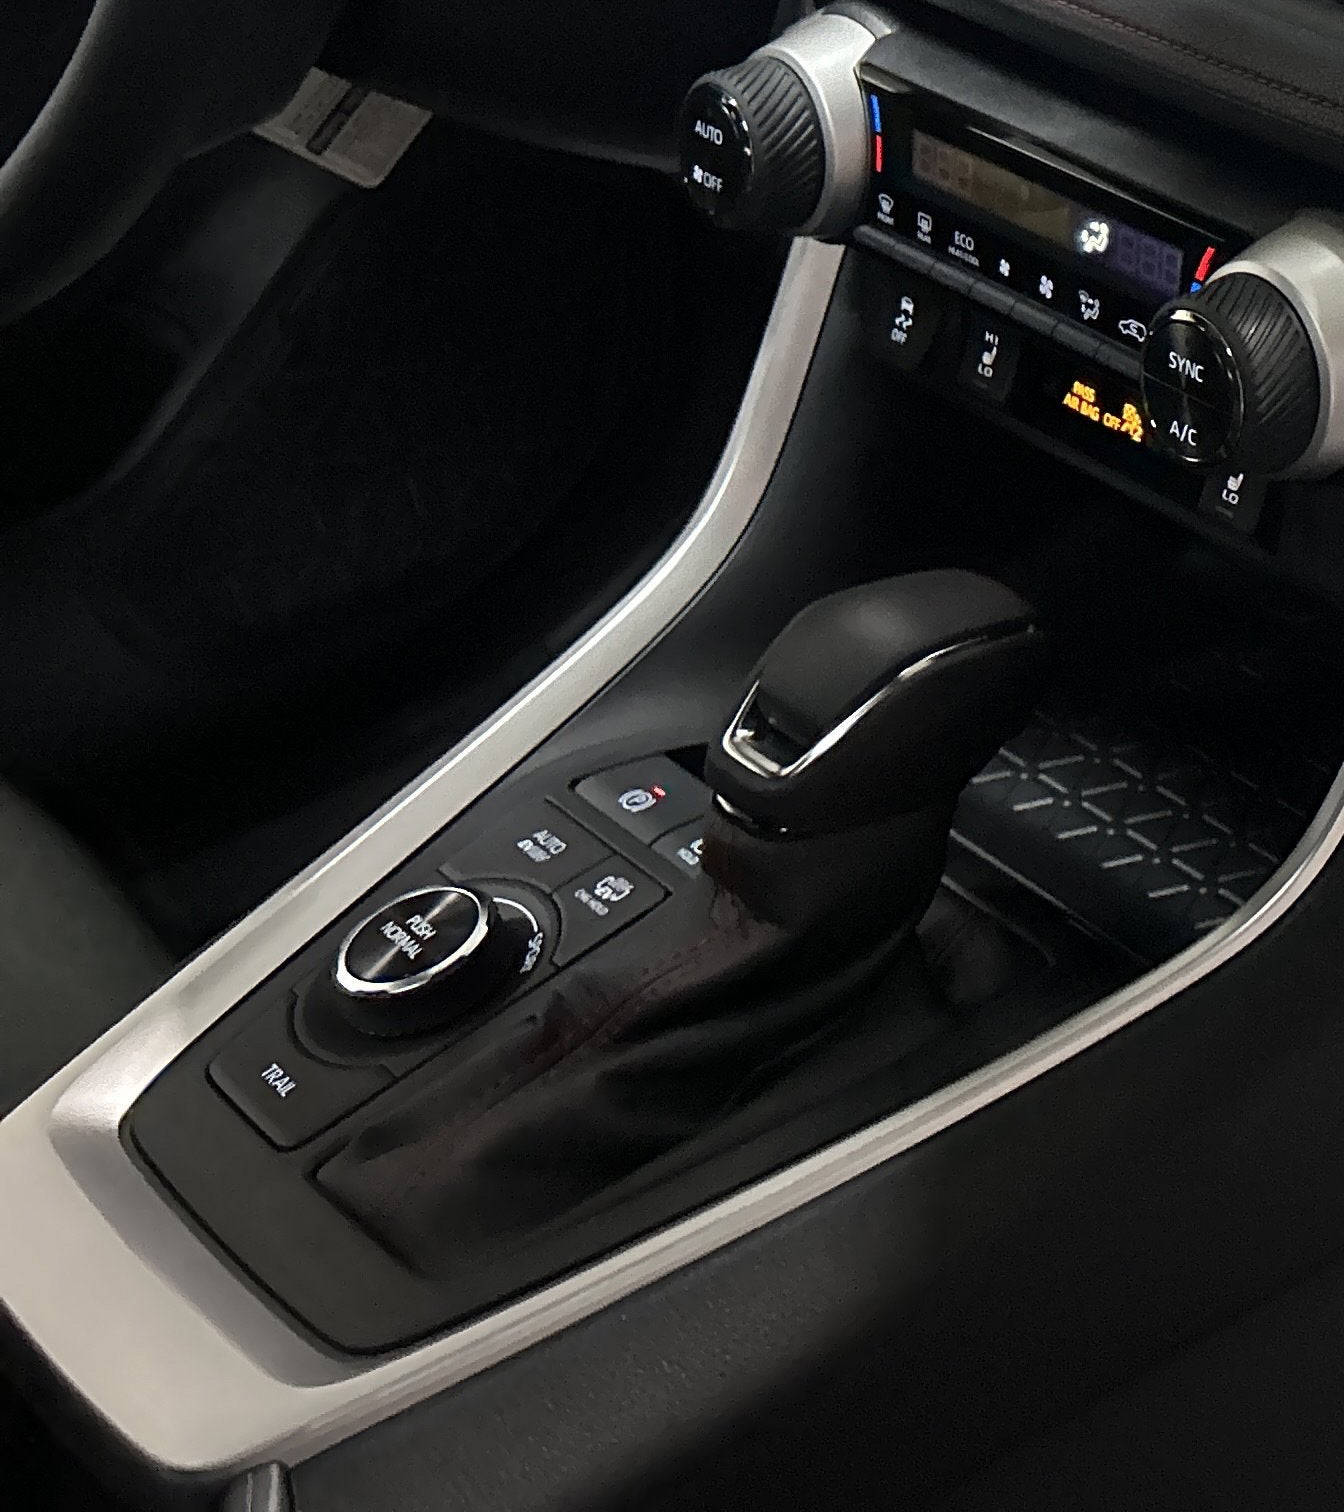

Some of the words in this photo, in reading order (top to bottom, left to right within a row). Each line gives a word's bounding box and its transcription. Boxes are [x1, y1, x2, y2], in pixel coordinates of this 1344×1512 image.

[694, 119, 723, 146] AUTO
[703, 171, 723, 192] OFF
[954, 230, 975, 251] ECO
[985, 330, 1000, 346] HI
[977, 363, 994, 378] LO
[1168, 350, 1205, 384] SYNC
[1169, 420, 1198, 447] A/C
[1221, 488, 1240, 505] LO
[379, 920, 424, 961] NORMAL
[405, 913, 438, 941] PUSH
[261, 1062, 297, 1098] TRAIL
